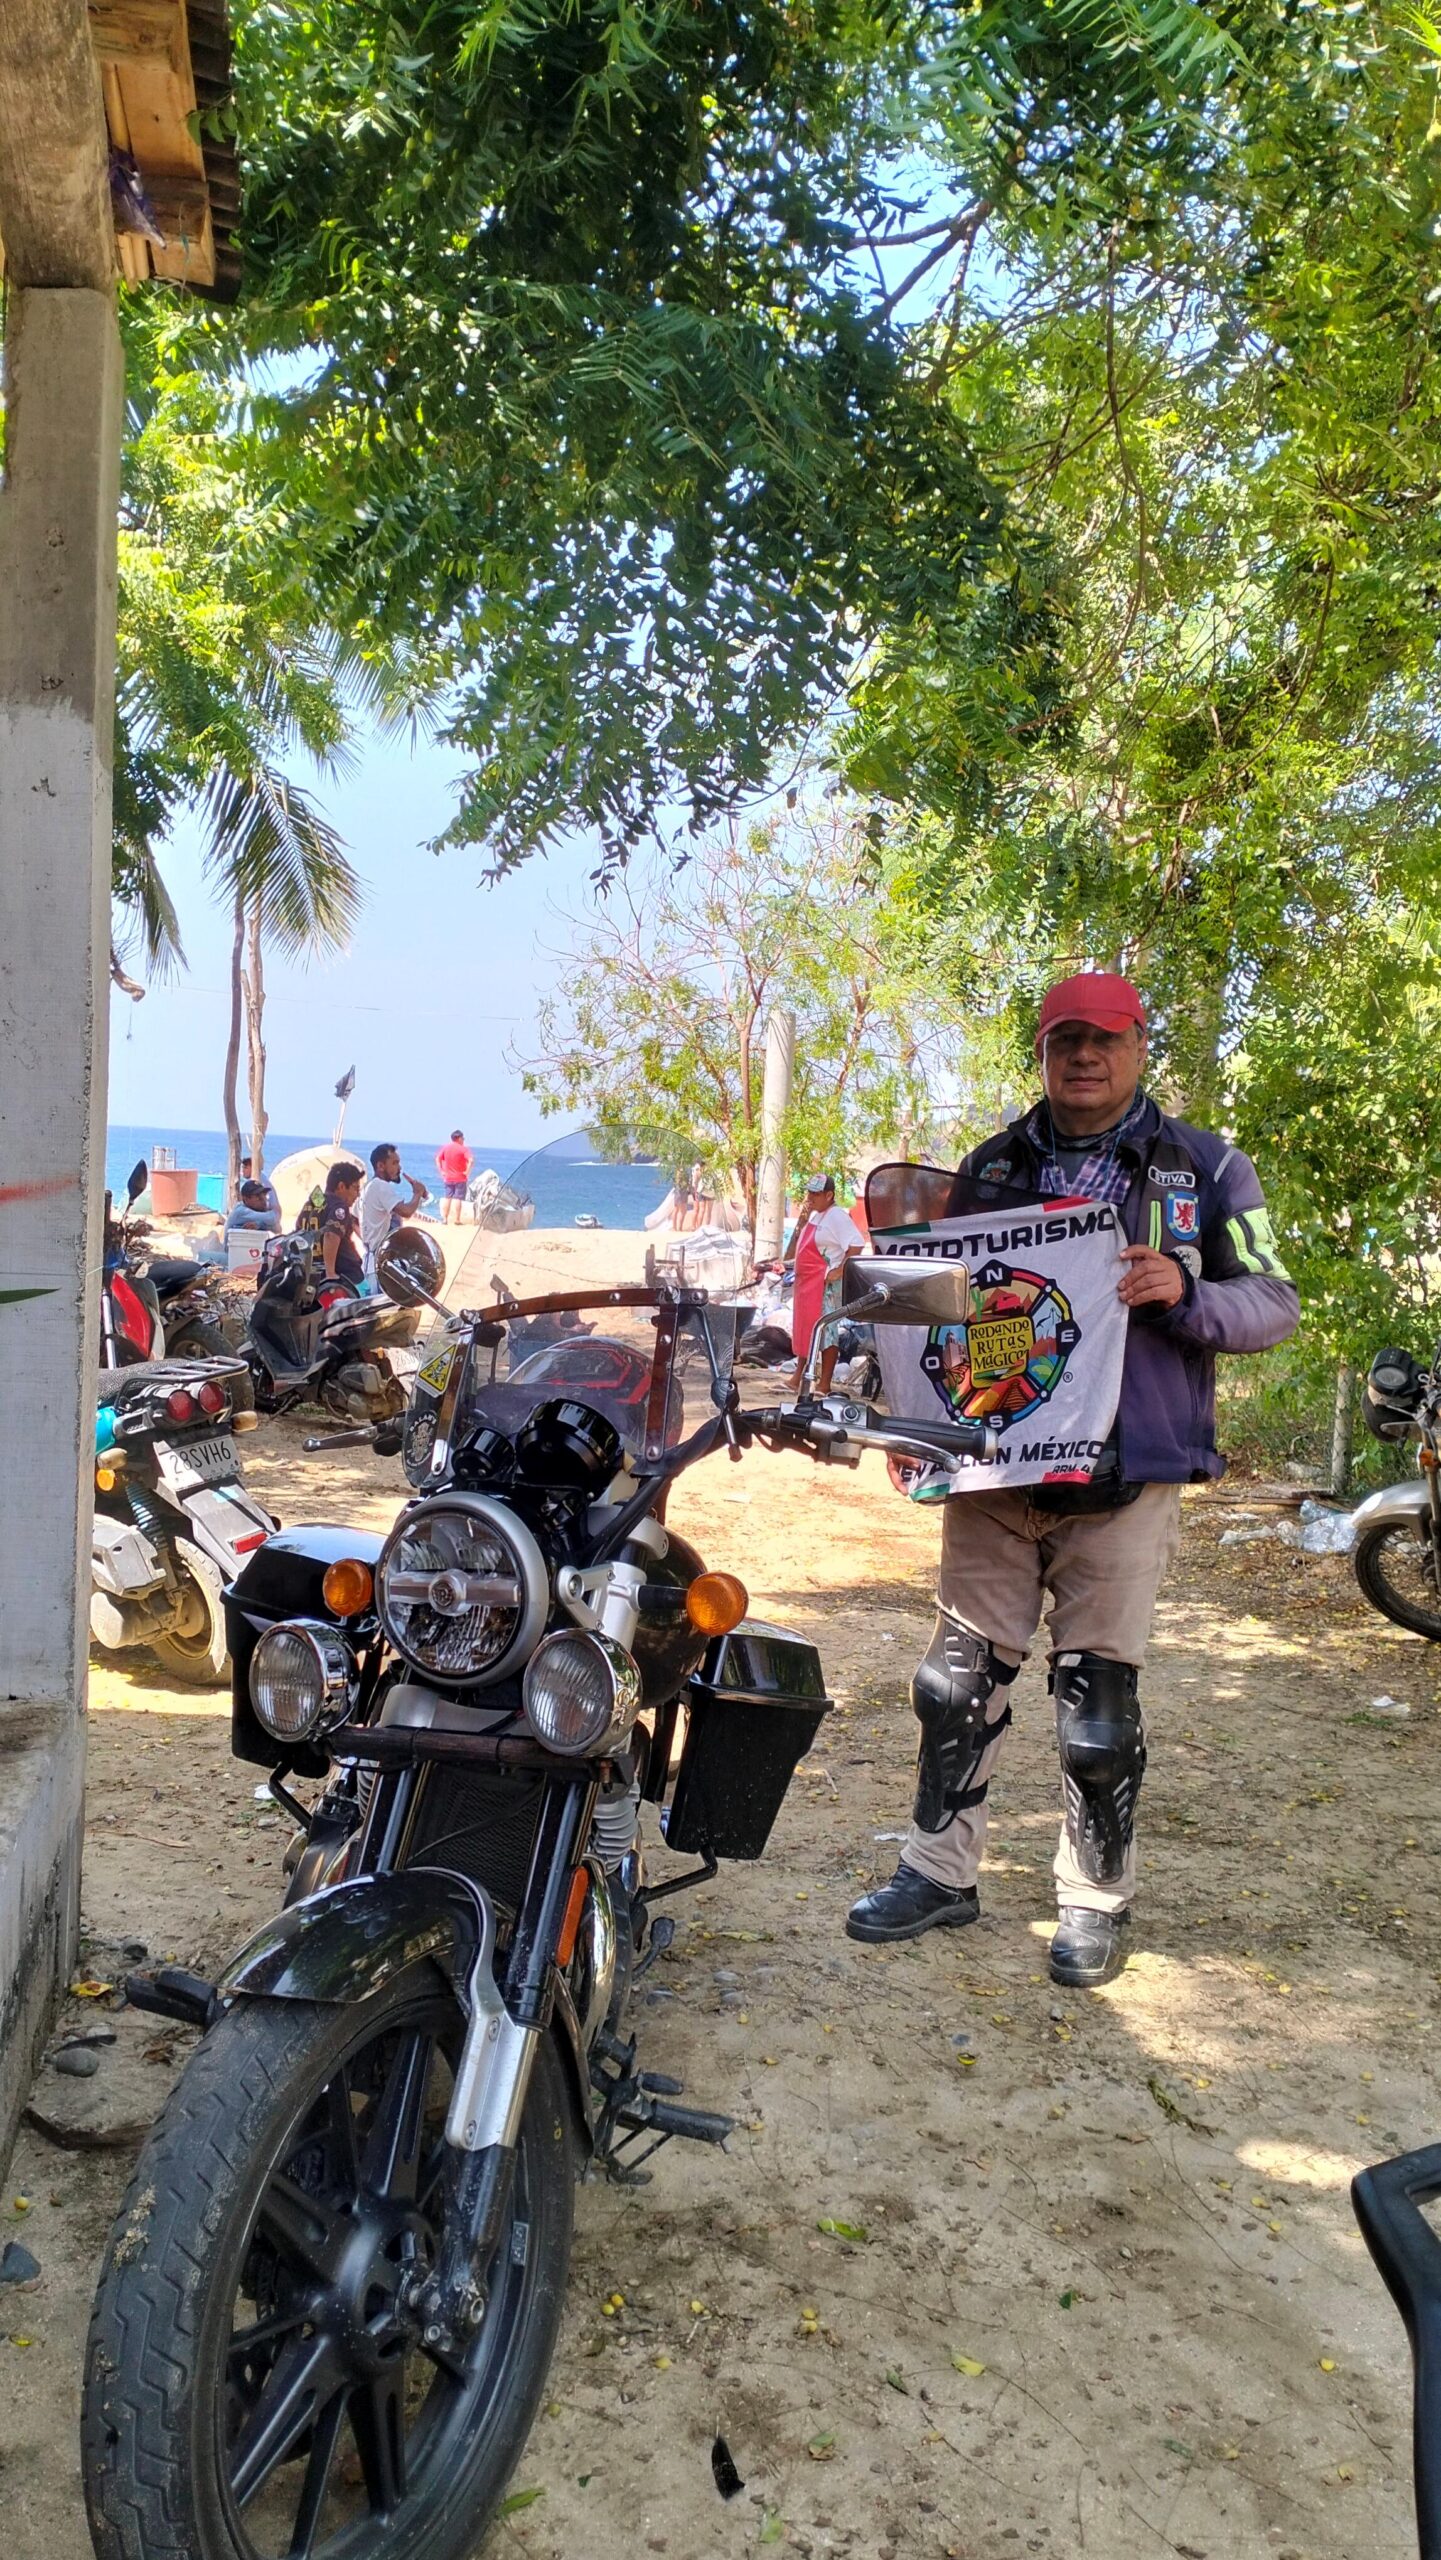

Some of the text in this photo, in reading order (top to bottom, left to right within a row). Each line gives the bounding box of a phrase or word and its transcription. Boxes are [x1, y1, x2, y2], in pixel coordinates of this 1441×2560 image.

[874, 1207, 1117, 1258] MOTOTURISMO
[986, 1268, 1003, 1282] N
[1061, 1329, 1075, 1343] E
[925, 1356, 939, 1370] O
[989, 1415, 1003, 1428] S
[1019, 1436, 1105, 1463] MÉXICO
[169, 1441, 231, 1474] 28SVH6
